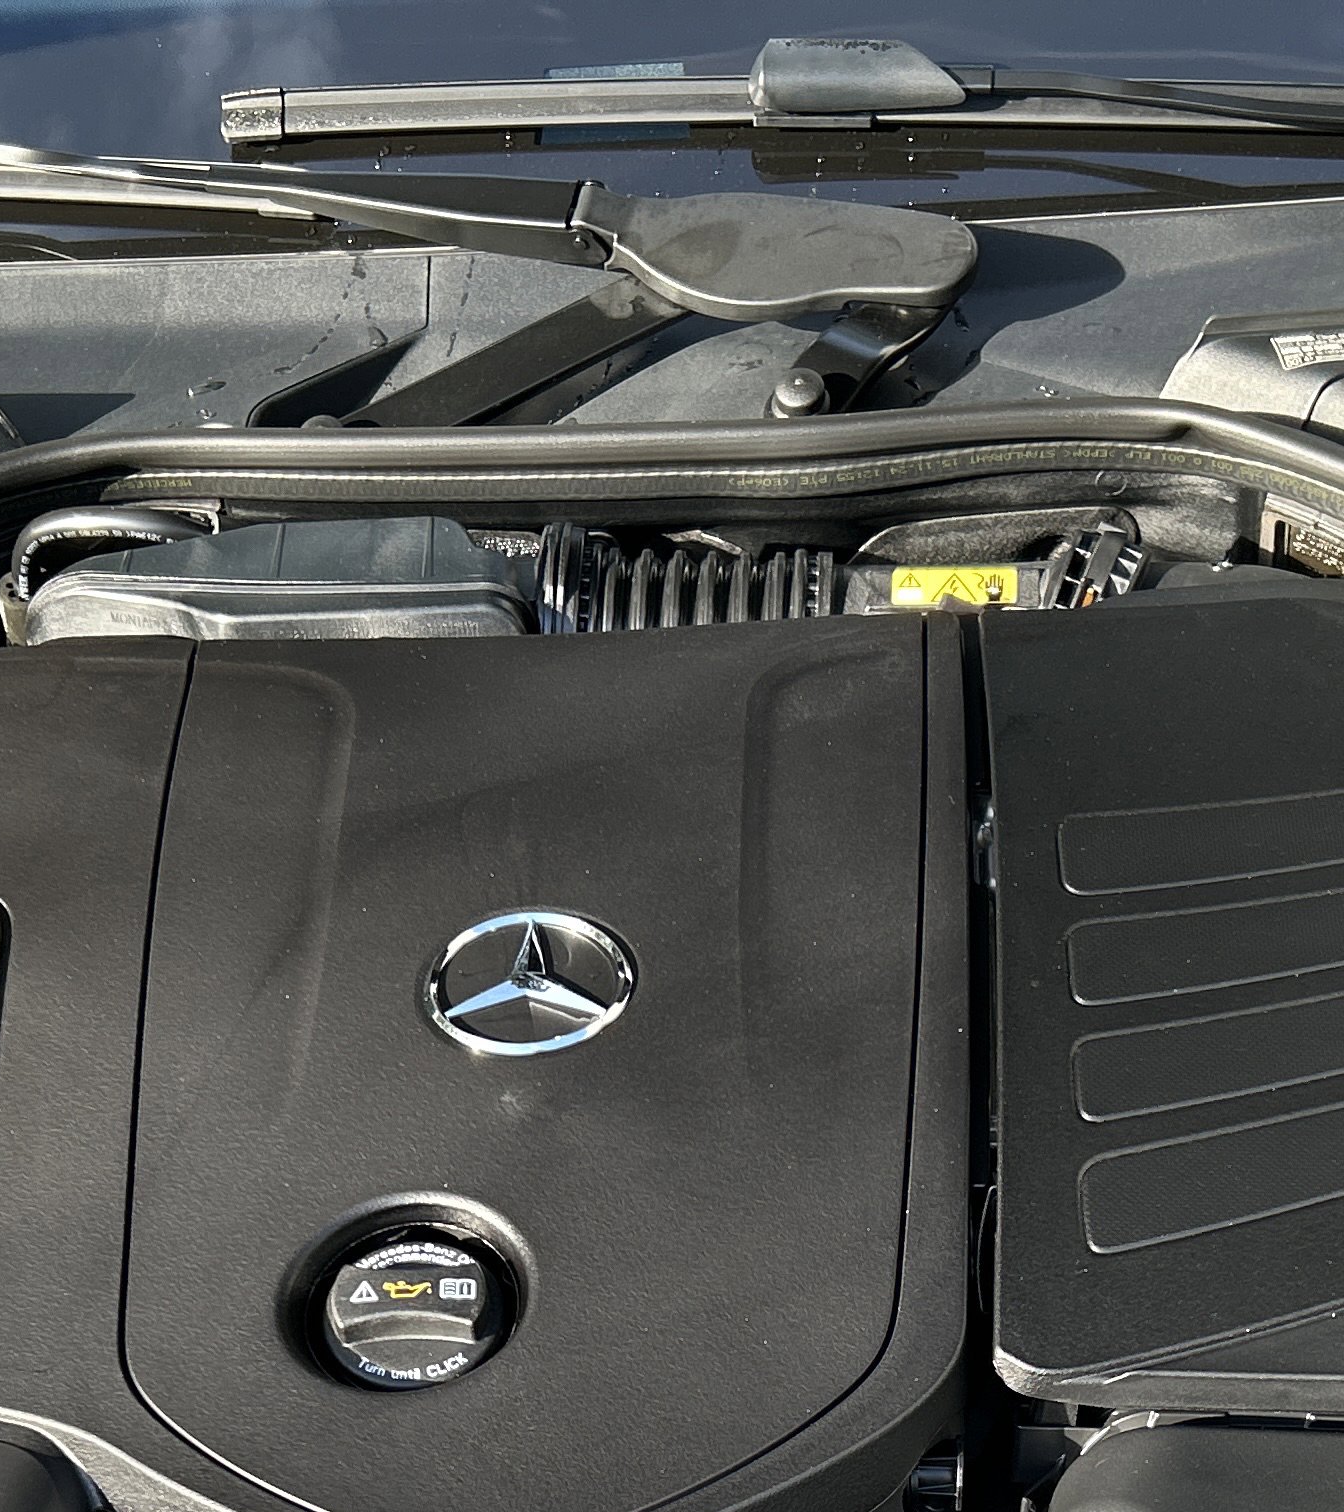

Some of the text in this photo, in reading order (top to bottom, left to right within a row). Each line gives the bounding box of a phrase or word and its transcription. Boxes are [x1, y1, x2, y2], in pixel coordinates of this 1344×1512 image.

[968, 448, 1057, 464] STAHLDRAHT
[358, 1353, 469, 1380] Turn until CLICK
